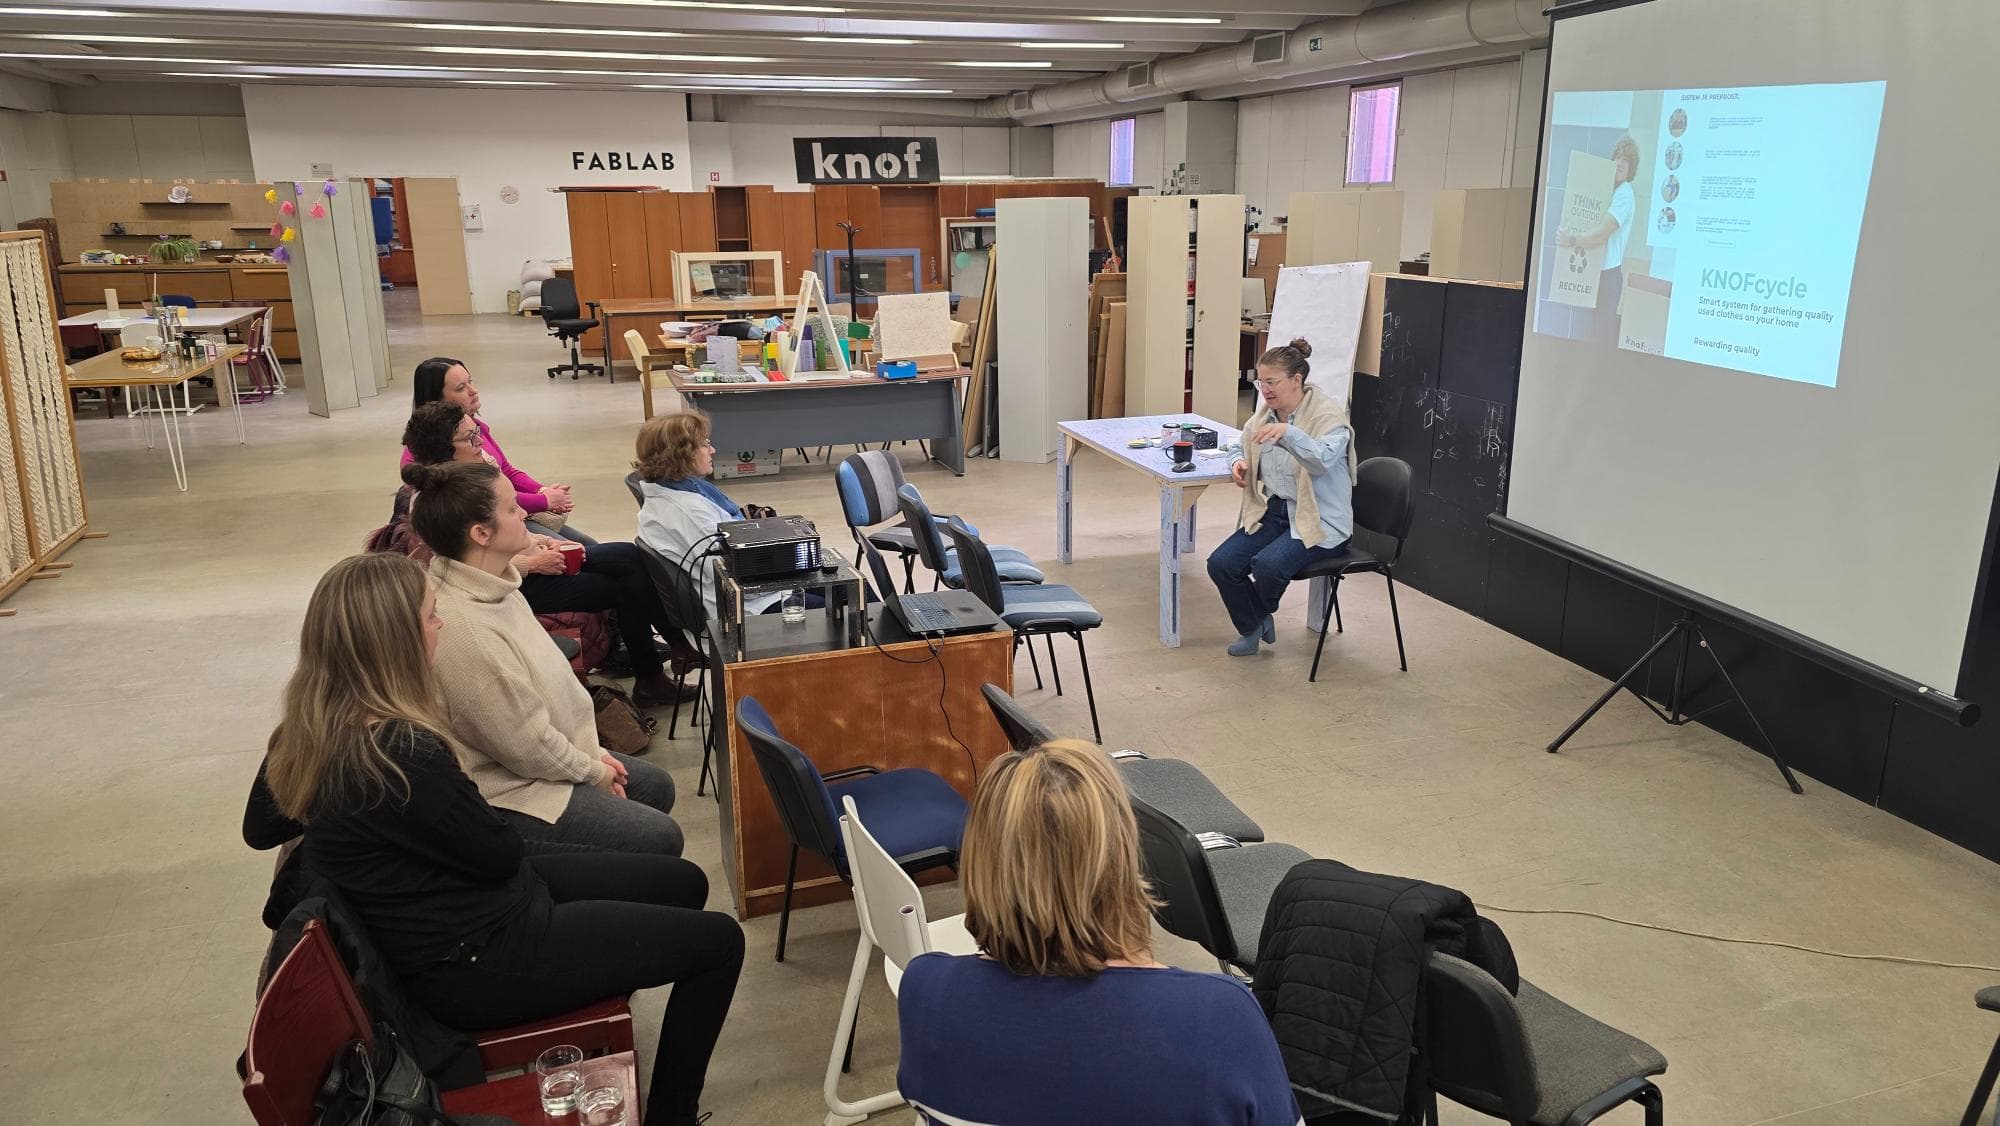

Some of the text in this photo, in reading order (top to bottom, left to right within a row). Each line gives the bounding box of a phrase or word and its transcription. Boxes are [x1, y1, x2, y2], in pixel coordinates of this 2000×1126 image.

[572, 152, 675, 171] FABLAB
[812, 142, 921, 179] knof
[1573, 193, 1602, 211] THINK
[1571, 207, 1600, 221] OUTSIDE
[1558, 281, 1592, 294] RECYCLE!
[1701, 268, 1807, 299] KNOFcycle
[1698, 307, 1799, 328] used clothes on your home
[1699, 296, 1834, 323] Smart system for gathering quality
[1694, 337, 1760, 356] Rewarding quality
